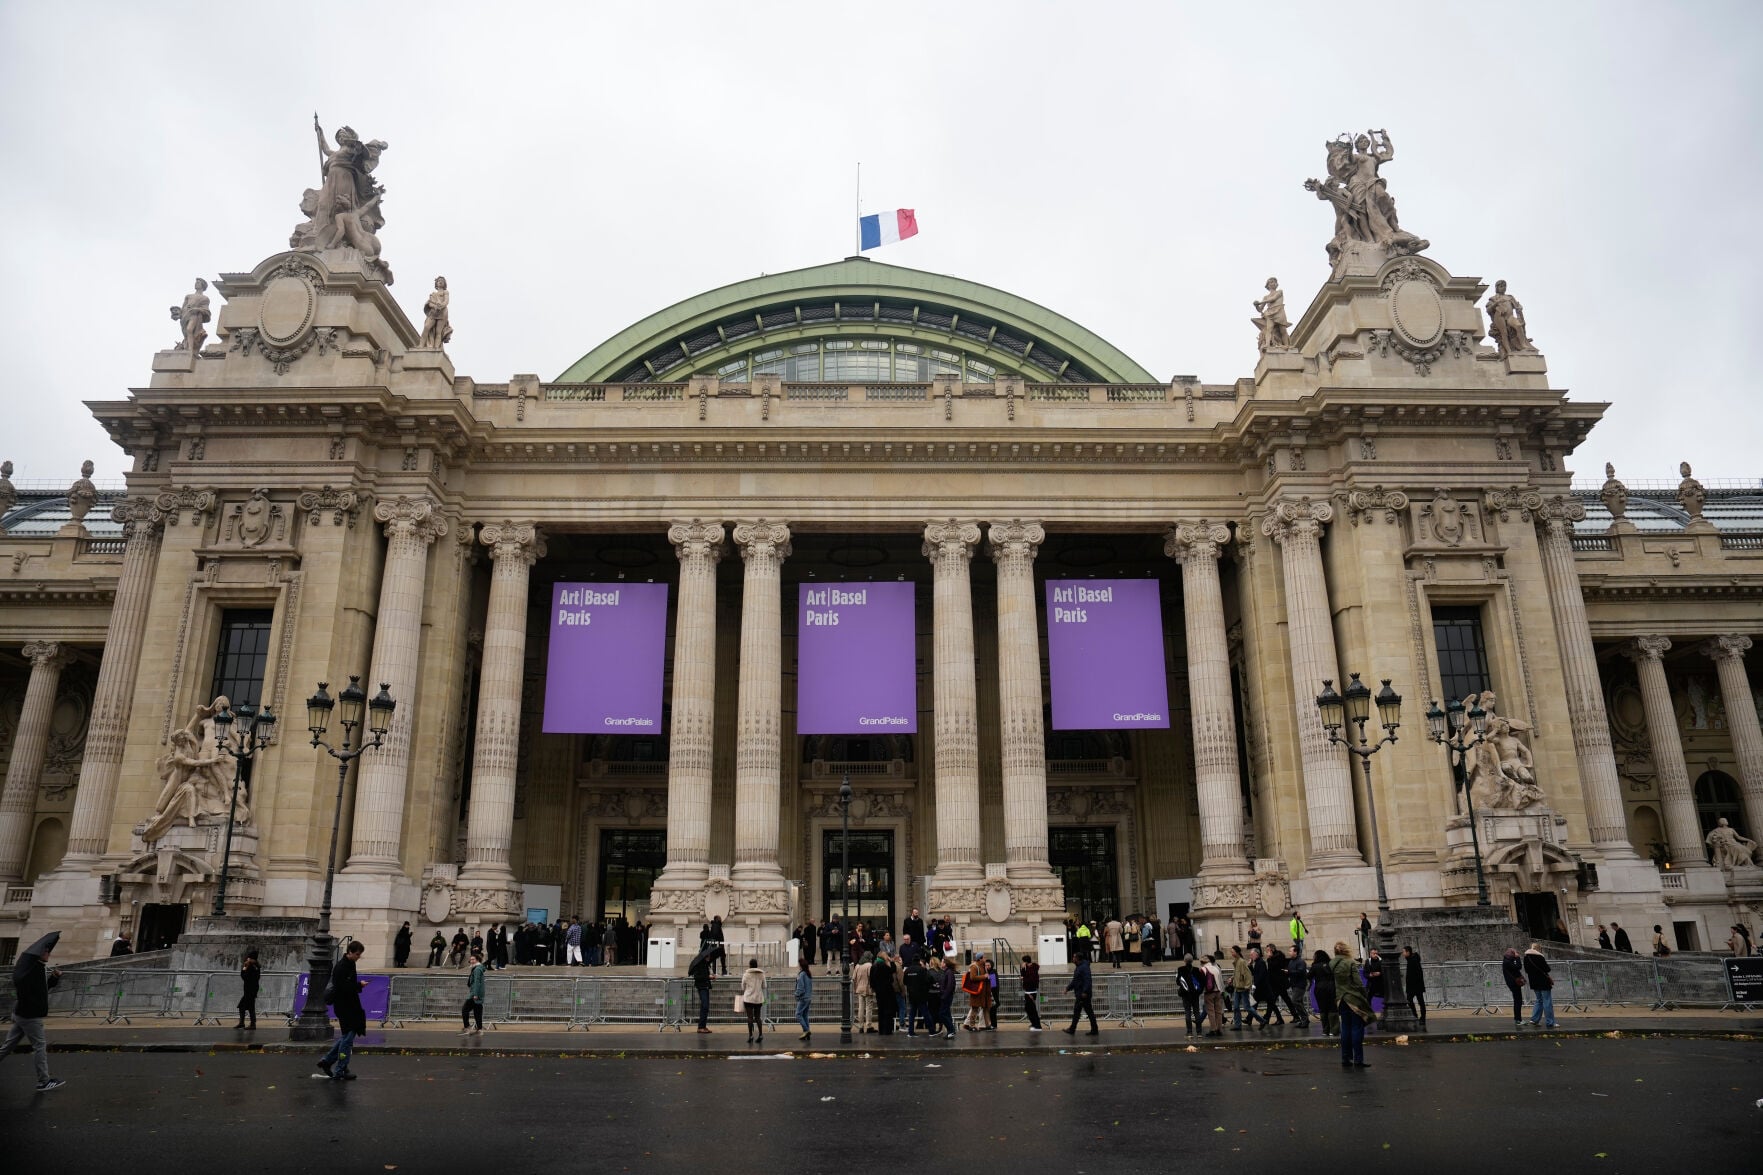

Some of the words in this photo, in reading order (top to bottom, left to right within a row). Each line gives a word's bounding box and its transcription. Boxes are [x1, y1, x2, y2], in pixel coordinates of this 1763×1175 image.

[558, 609, 591, 626] Paris
[806, 609, 840, 626] Paris
[1054, 607, 1088, 623] Paris
[604, 716, 654, 726] GrandPalais
[859, 716, 909, 726] GrandPalais
[1112, 712, 1162, 722] GrandPalais
